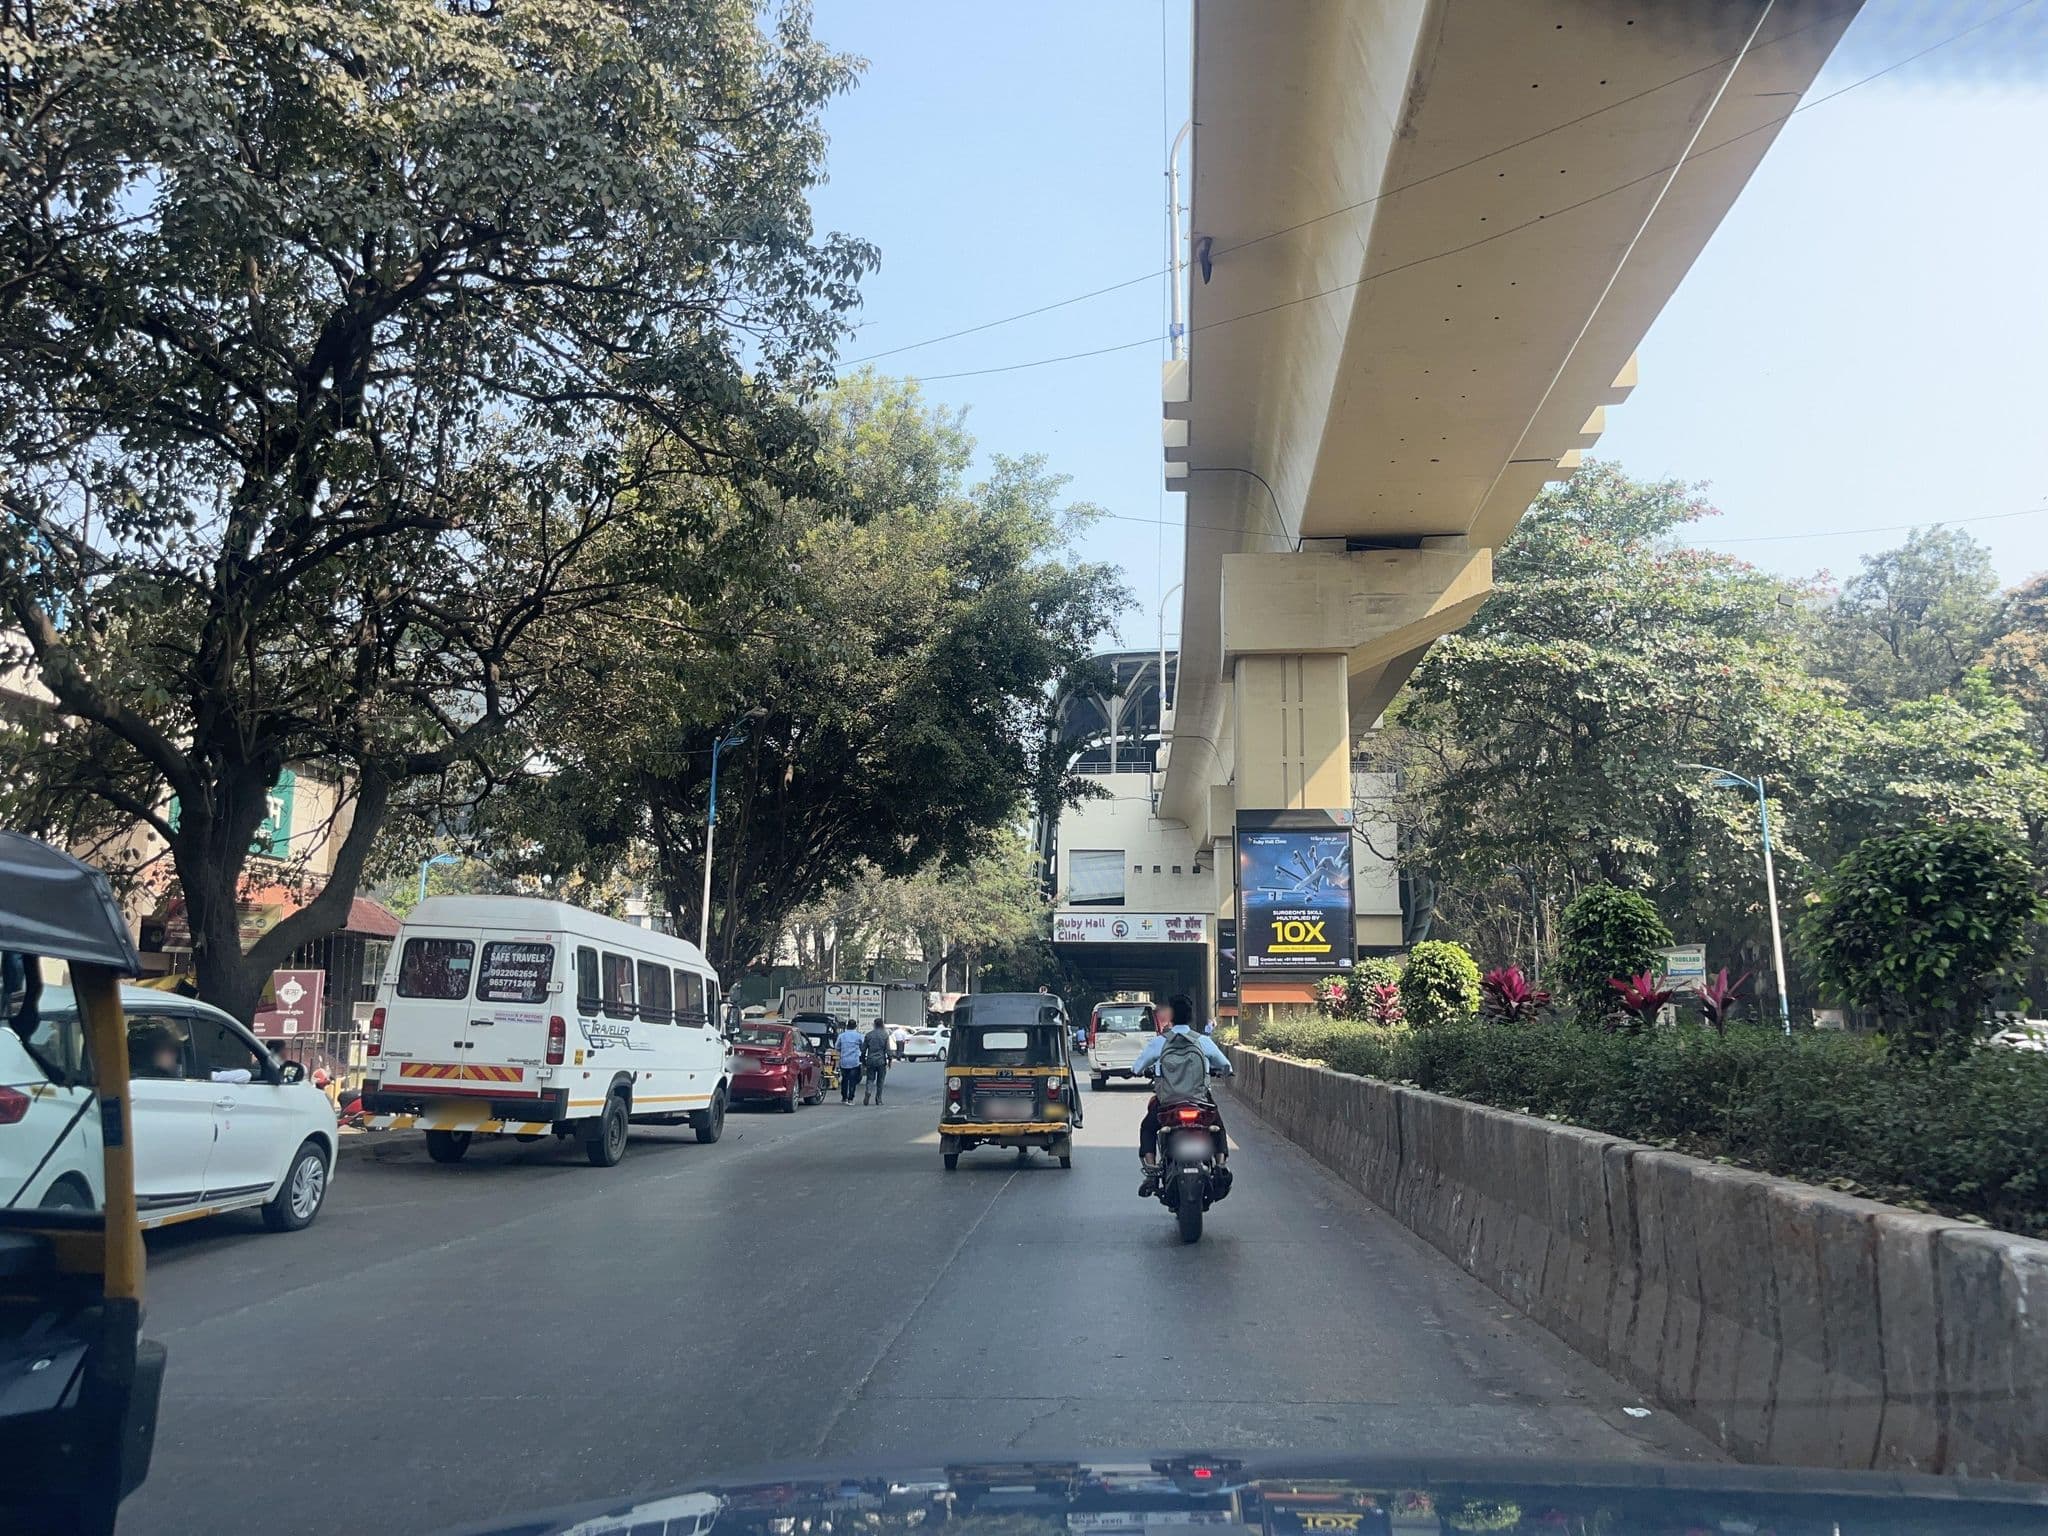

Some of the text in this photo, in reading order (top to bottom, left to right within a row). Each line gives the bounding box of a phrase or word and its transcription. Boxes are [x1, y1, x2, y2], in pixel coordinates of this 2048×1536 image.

[1057, 918, 1105, 929] Ruby Hall
[1058, 930, 1086, 941] Clinic
[1271, 921, 1326, 943] 10X
[491, 951, 546, 963] SAFE TRAVELS
[828, 984, 880, 996] QUICK
[787, 993, 822, 1011] QUICK
[591, 1019, 631, 1036] TRAVELLER
